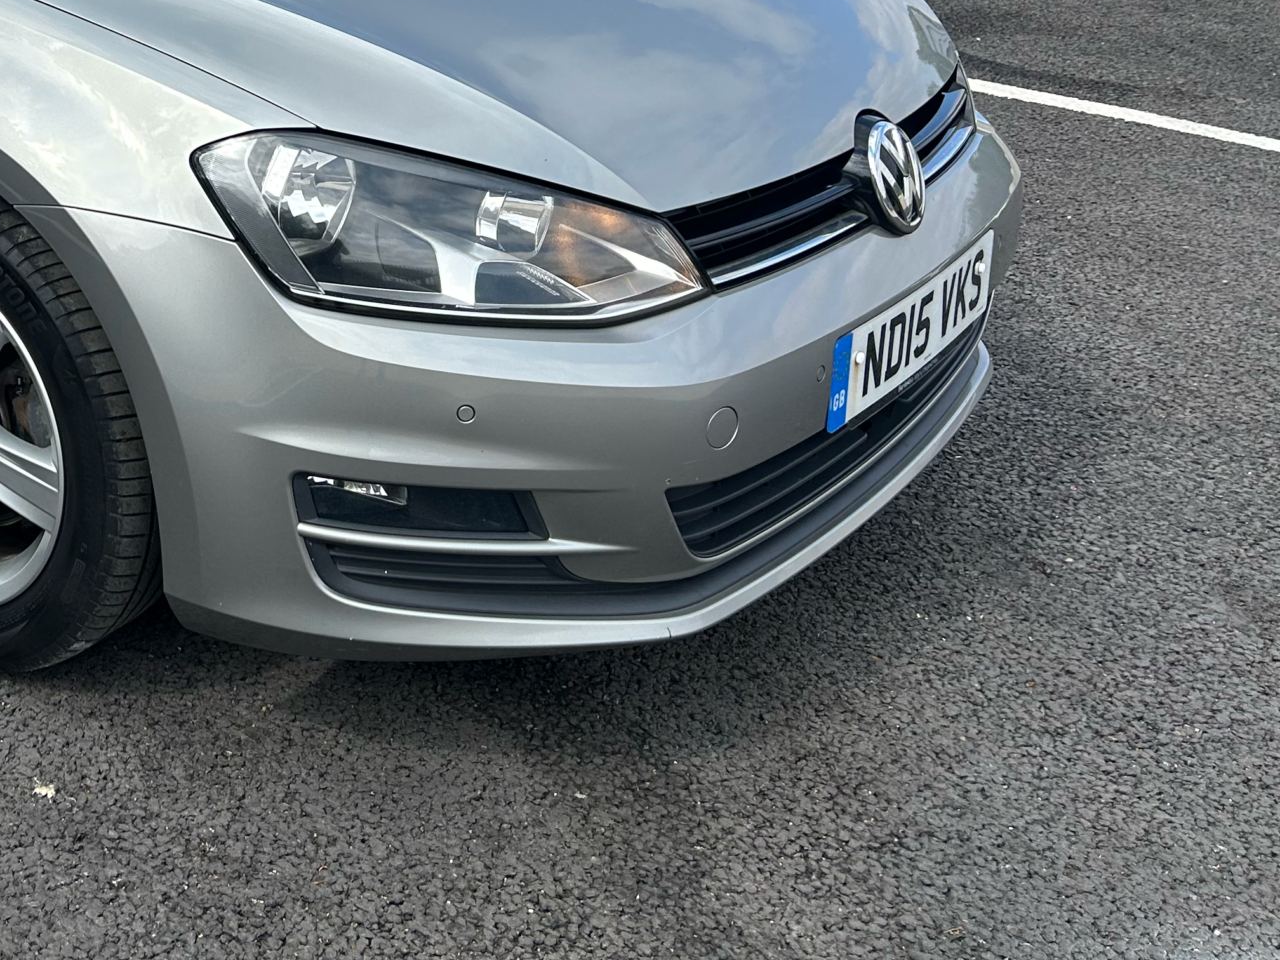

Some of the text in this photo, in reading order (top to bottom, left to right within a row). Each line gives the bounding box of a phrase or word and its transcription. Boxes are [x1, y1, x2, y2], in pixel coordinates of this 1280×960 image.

[862, 290, 935, 397] ND15
[940, 249, 984, 338] VKS
[832, 389, 846, 412] GB
